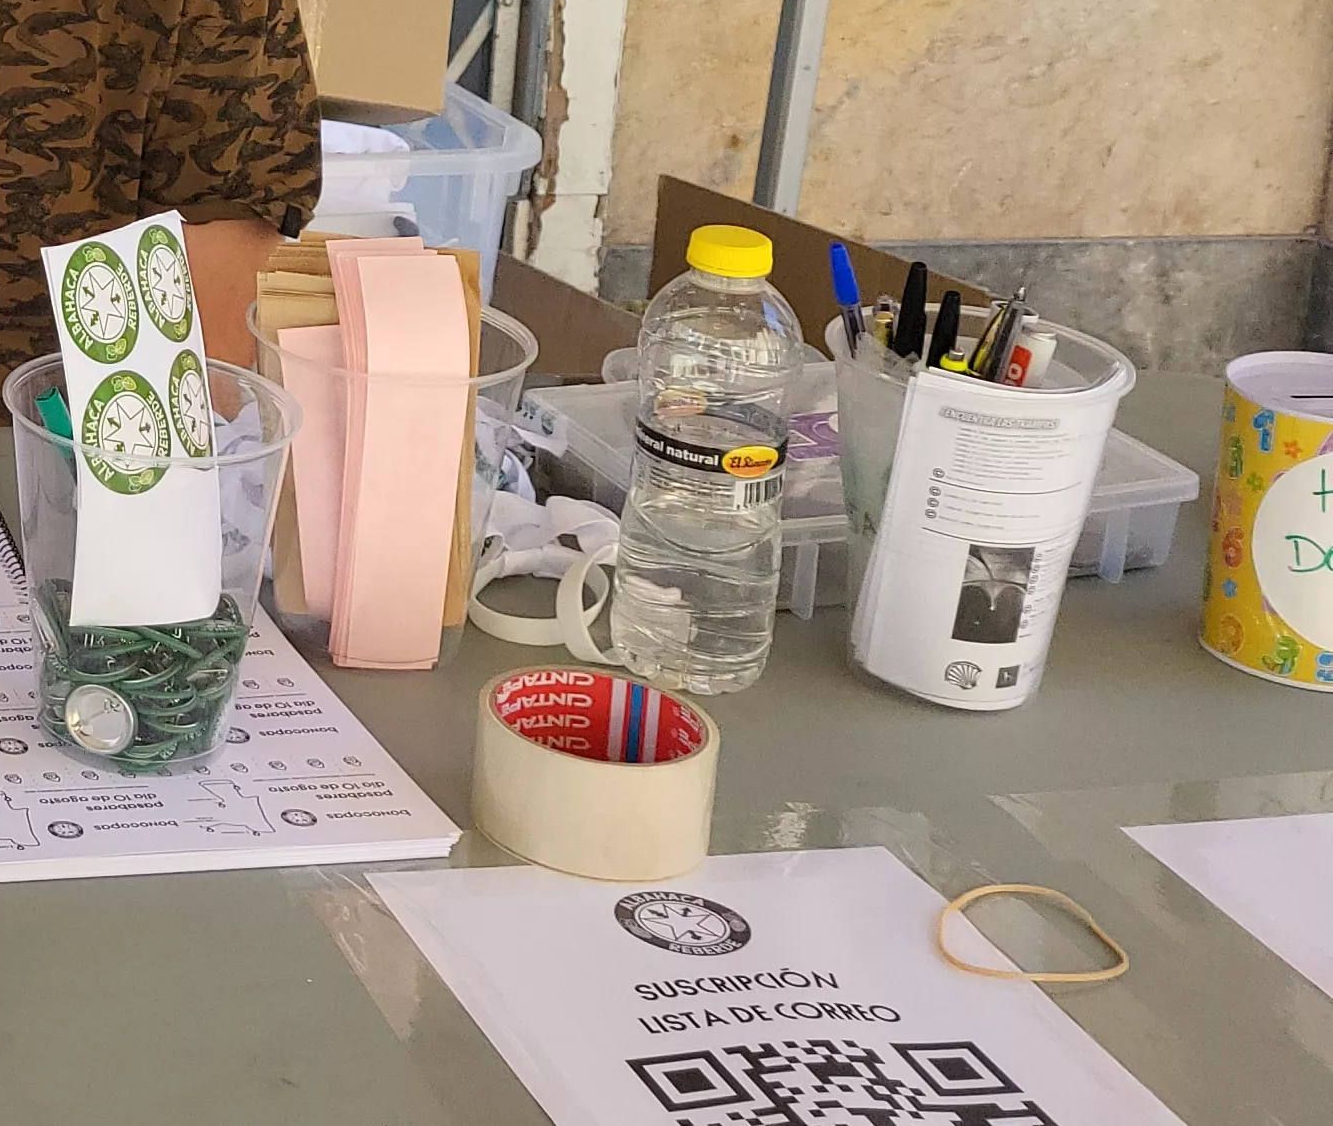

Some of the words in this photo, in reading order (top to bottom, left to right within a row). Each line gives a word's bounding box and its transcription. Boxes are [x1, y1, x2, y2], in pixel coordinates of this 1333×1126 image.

[138, 249, 166, 329] ALBAHACA
[64, 267, 94, 351] ALBAHACA
[666, 446, 719, 467] natural
[618, 892, 705, 910] ALBAHACA
[668, 939, 743, 955] REBERDE
[634, 968, 840, 1000] SUSCRIPCIÓN
[637, 1008, 729, 1034] LISTA
[727, 1003, 773, 1024] DE
[775, 1002, 902, 1023] CORREO
